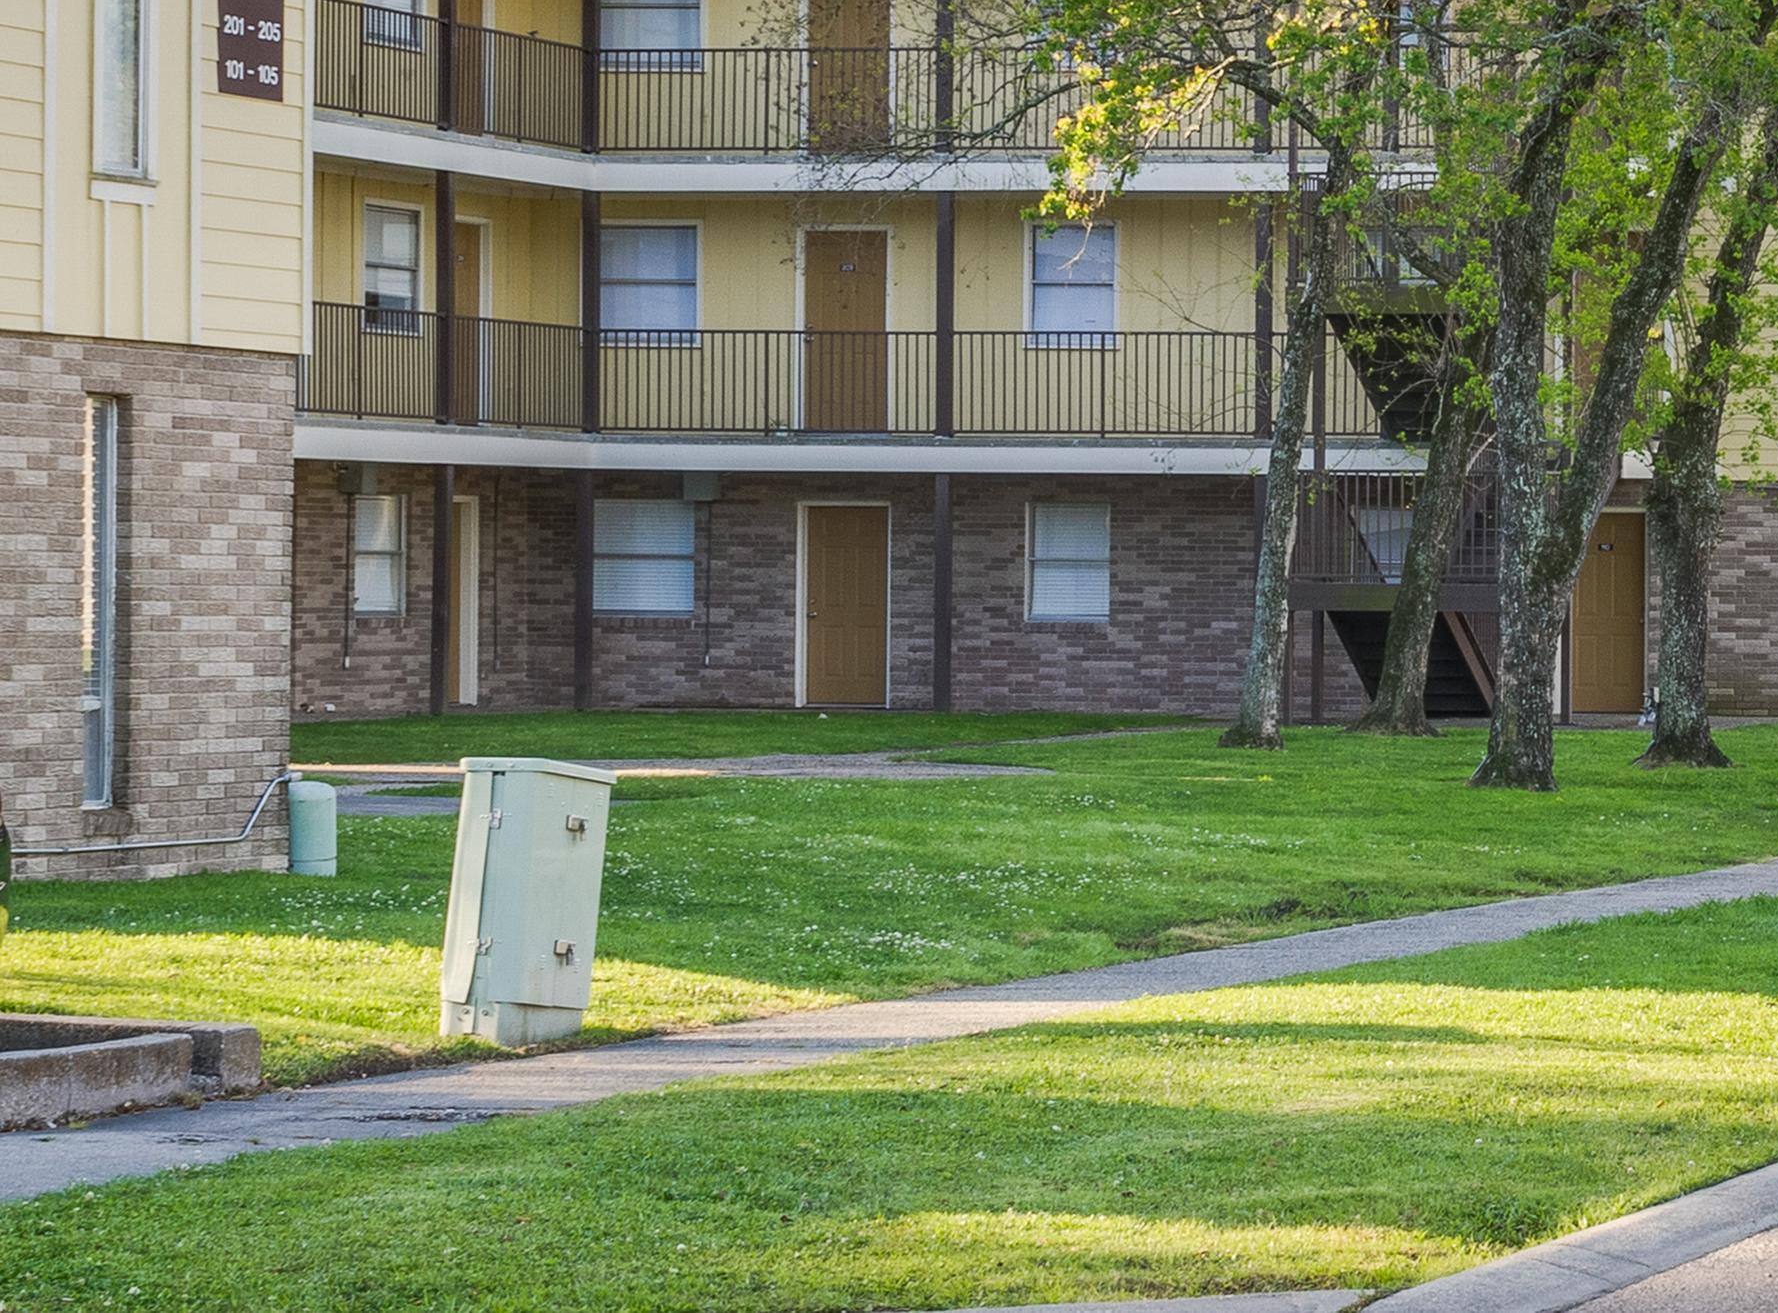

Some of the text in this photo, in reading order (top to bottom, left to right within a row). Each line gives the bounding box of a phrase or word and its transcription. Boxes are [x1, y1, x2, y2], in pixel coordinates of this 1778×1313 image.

[223, 15, 244, 36] 201
[257, 20, 281, 42] 205
[225, 60, 244, 80] 101
[257, 64, 279, 86] 105
